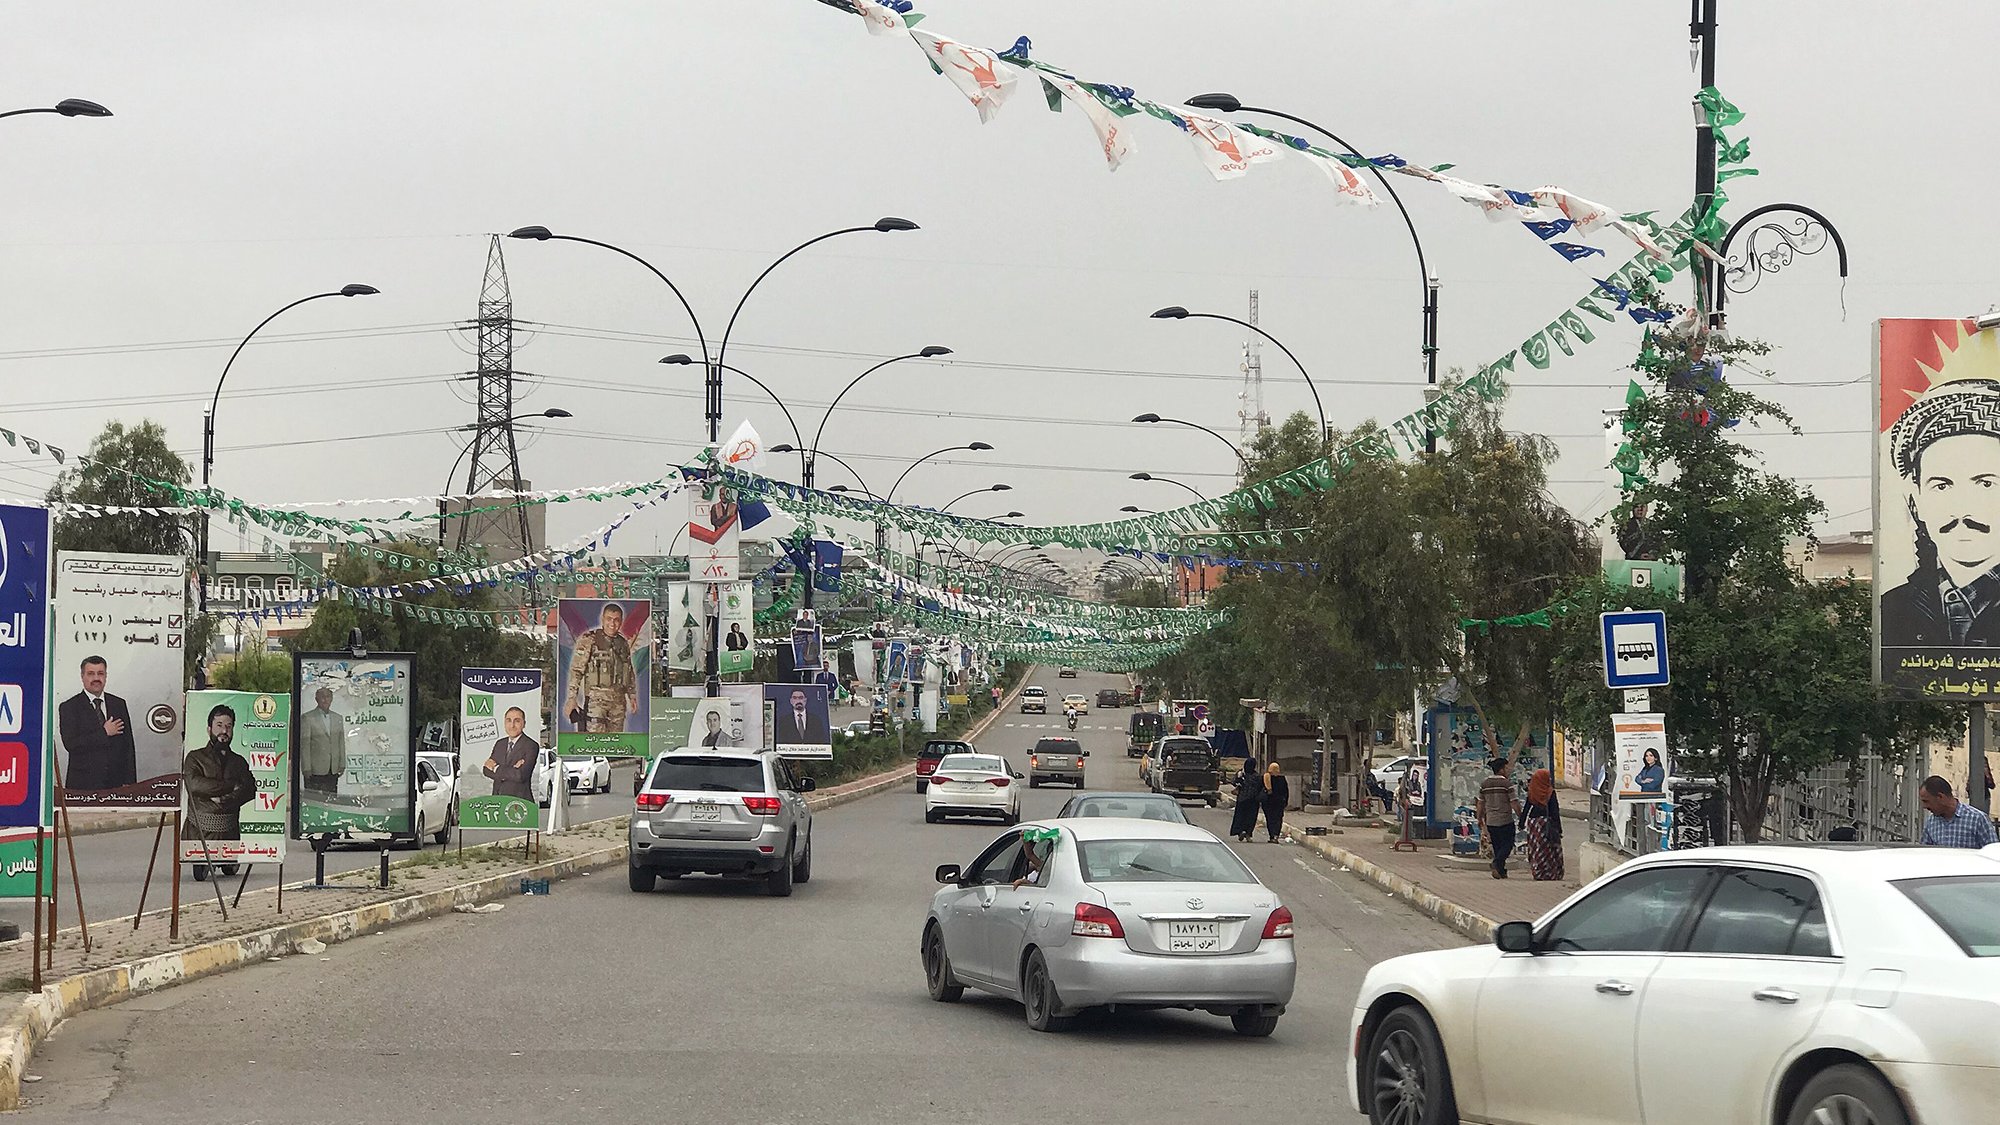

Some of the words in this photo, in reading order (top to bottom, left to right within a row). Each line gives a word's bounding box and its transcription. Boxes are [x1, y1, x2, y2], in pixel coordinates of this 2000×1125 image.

[1901, 654, 1954, 670] فەرماندە
[509, 676, 534, 684] مقداد
[469, 698, 490, 714] ١٨
[0, 757, 17, 784] اس
[350, 771, 359, 783] ٦
[151, 780, 178, 788] لیستی
[65, 793, 97, 802] کوردستا
[476, 810, 500, 822] ١٦٢
[1176, 924, 1214, 934] ١٨٧١٠٢
